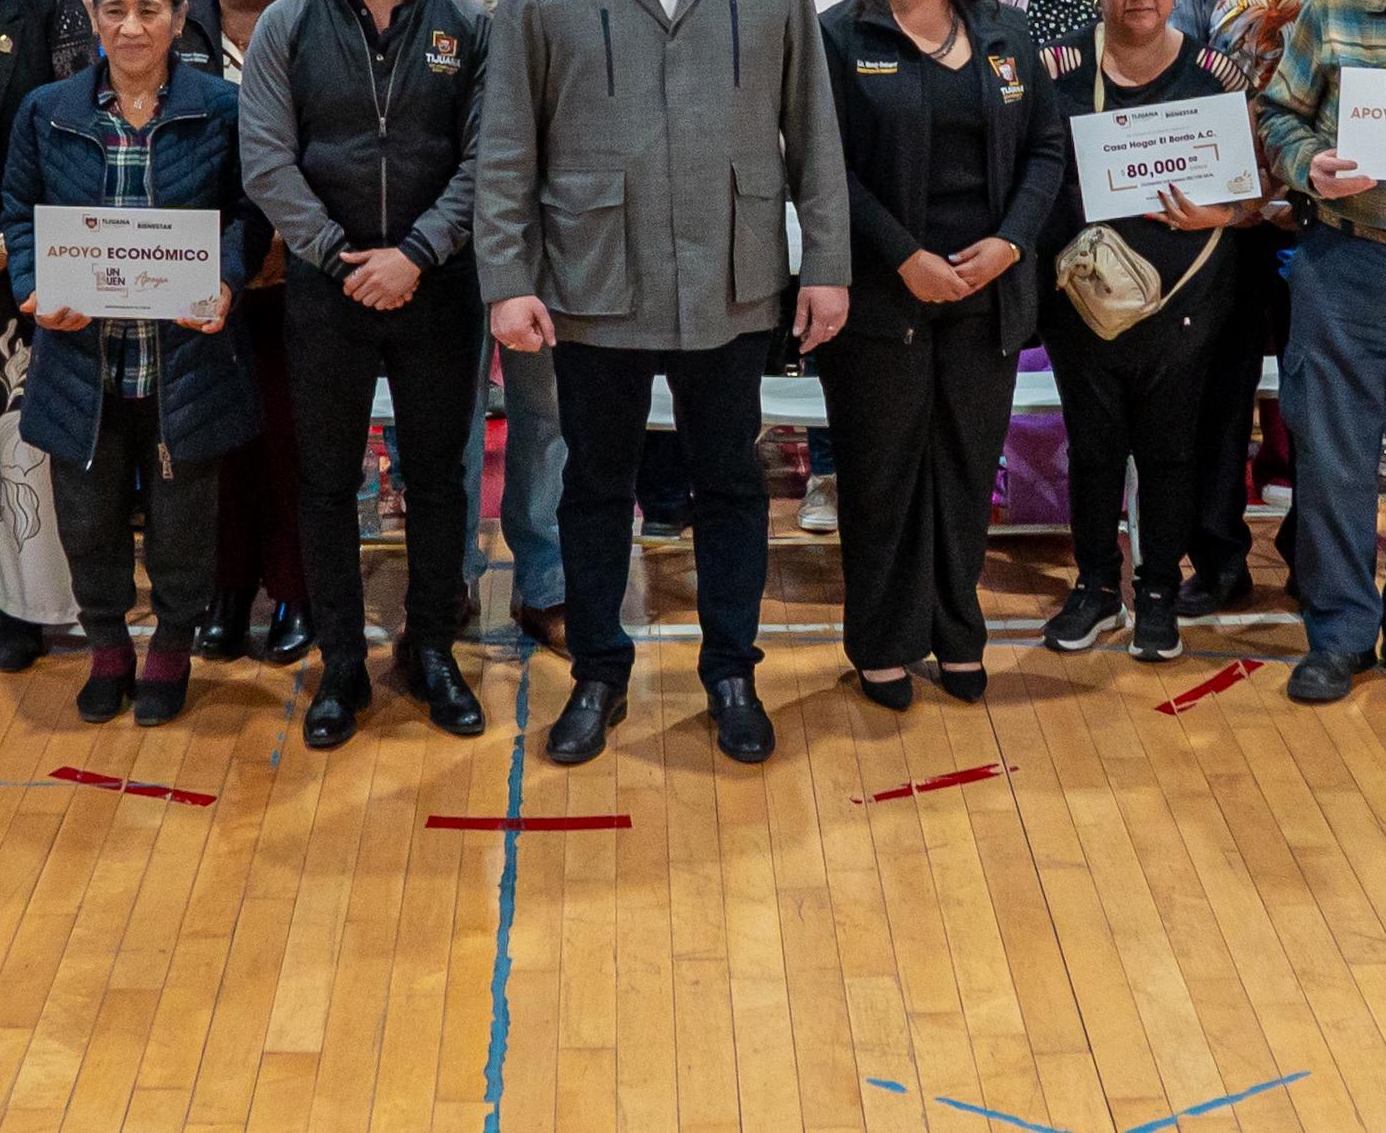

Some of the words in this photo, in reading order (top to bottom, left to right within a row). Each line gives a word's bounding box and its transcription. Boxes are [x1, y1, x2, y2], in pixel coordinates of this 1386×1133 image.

[1103, 143, 1127, 153] Casa
[1129, 139, 1157, 151] Hogar
[1159, 136, 1167, 145] El
[1169, 133, 1195, 144] Bordo
[1197, 129, 1217, 140] A.C.
[1126, 157, 1187, 179] 80,000
[46, 245, 102, 259] APOYO
[107, 244, 210, 262] ECONÓMICO
[106, 267, 121, 277] UN
